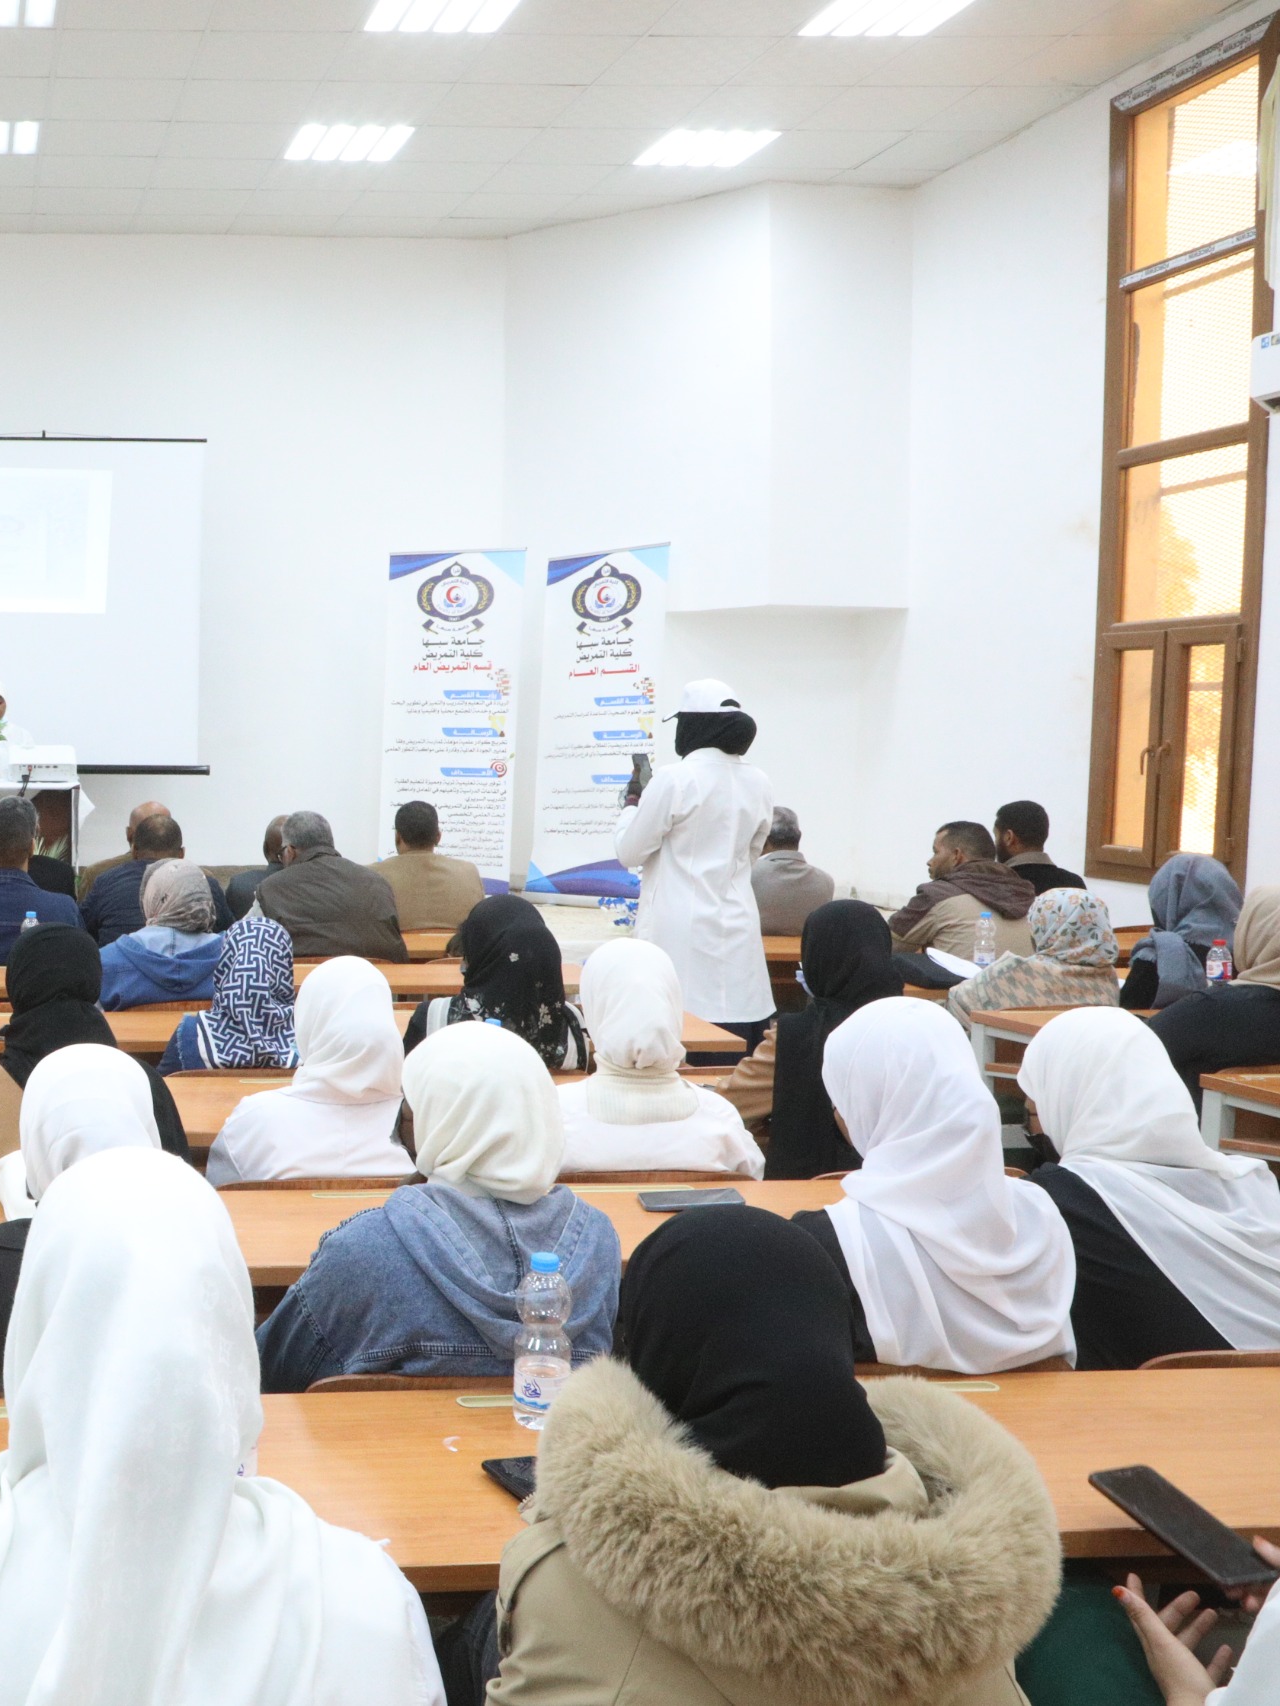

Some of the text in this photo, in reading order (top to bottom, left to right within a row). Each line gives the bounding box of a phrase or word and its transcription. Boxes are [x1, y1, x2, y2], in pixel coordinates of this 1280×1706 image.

[422, 649, 483, 661] كلية التمريض
[576, 648, 632, 663] كلية التمريض
[413, 661, 492, 673] قسم التمريض العام
